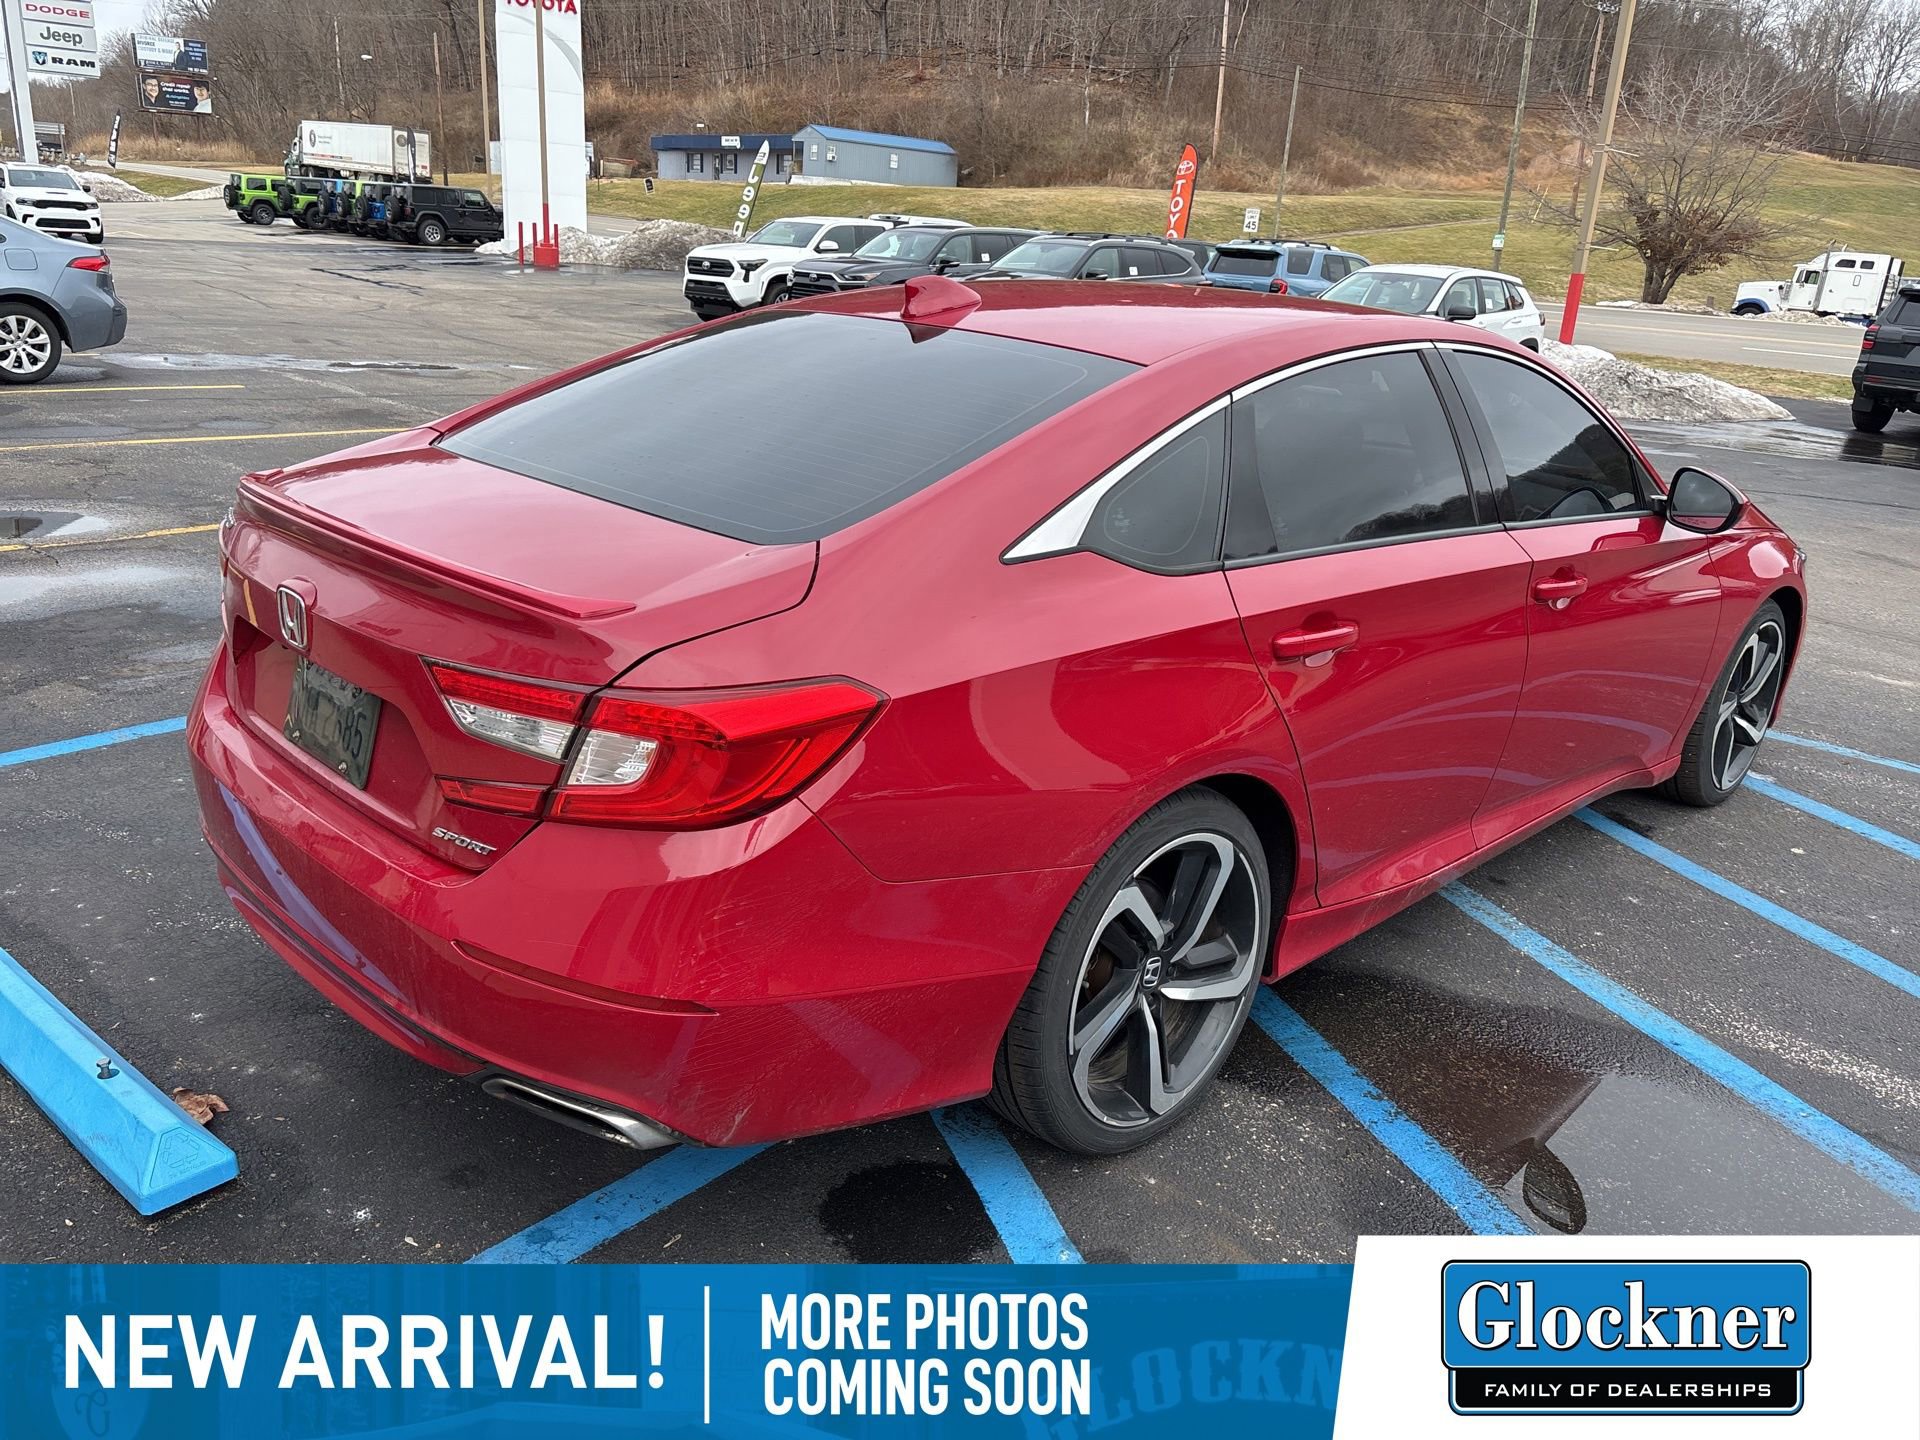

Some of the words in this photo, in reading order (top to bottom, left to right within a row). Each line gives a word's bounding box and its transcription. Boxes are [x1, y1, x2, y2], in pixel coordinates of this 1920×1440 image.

[25, 3, 91, 19] DODGE
[503, 0, 578, 15] OOTA
[39, 26, 83, 47] Jeep
[51, 57, 96, 68] RAM
[1245, 220, 1257, 230] 45
[431, 826, 497, 856] SPORT
